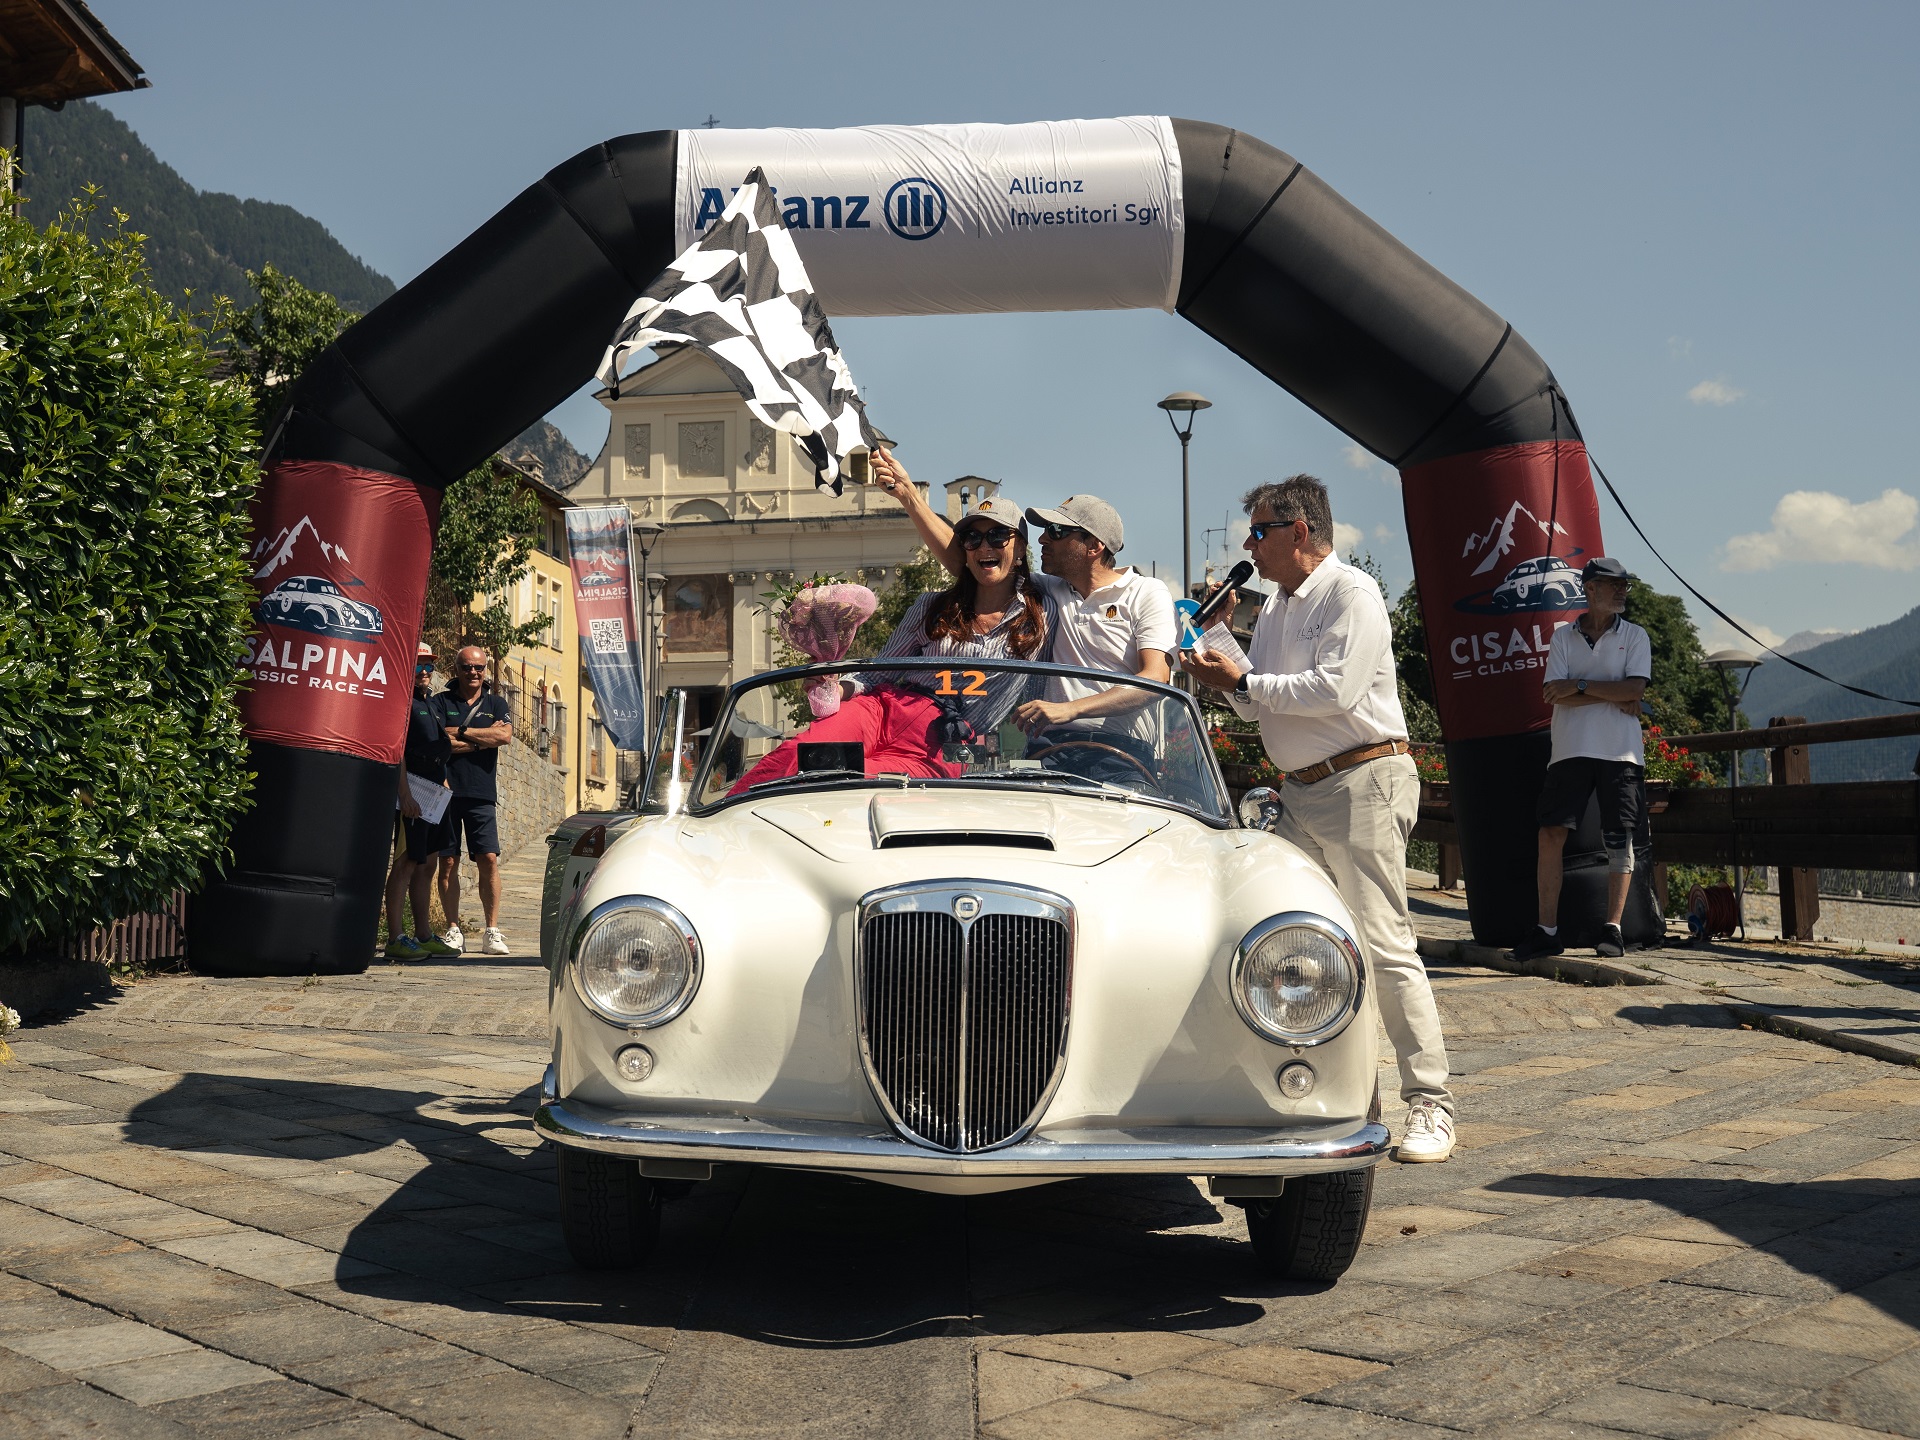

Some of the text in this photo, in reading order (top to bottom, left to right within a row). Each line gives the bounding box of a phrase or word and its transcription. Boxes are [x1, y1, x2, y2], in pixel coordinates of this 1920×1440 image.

[1009, 176, 1084, 195] Allianz
[695, 186, 871, 230] Aanz
[1011, 203, 1160, 226] Investitori Sgr
[233, 636, 388, 685] SALPINA
[1477, 656, 1549, 676] CLASSI
[237, 668, 359, 695] ASSIC RACE
[934, 670, 988, 696] 12
